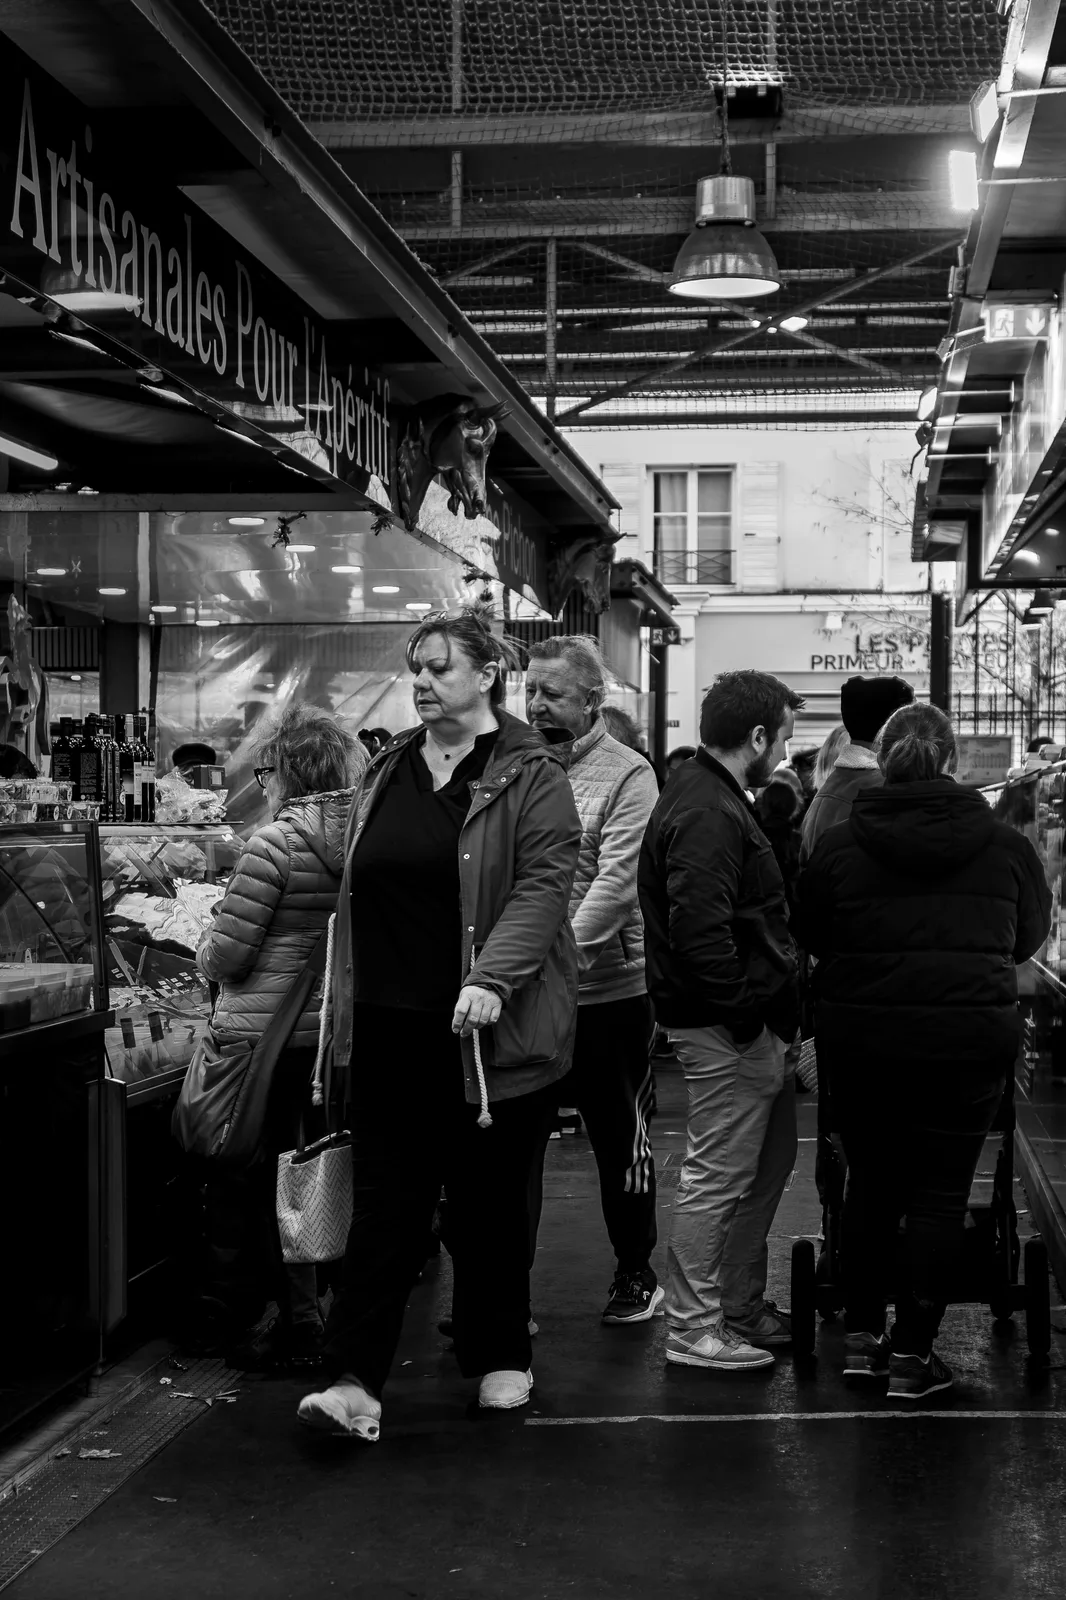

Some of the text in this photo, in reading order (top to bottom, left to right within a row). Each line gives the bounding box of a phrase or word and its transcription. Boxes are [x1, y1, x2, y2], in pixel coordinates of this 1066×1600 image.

[10, 76, 228, 376] Artisanales
[235, 259, 299, 415] Pour
[502, 499, 537, 588] Pichon
[811, 653, 904, 670] PRIMEUR
[855, 633, 899, 653] LES
